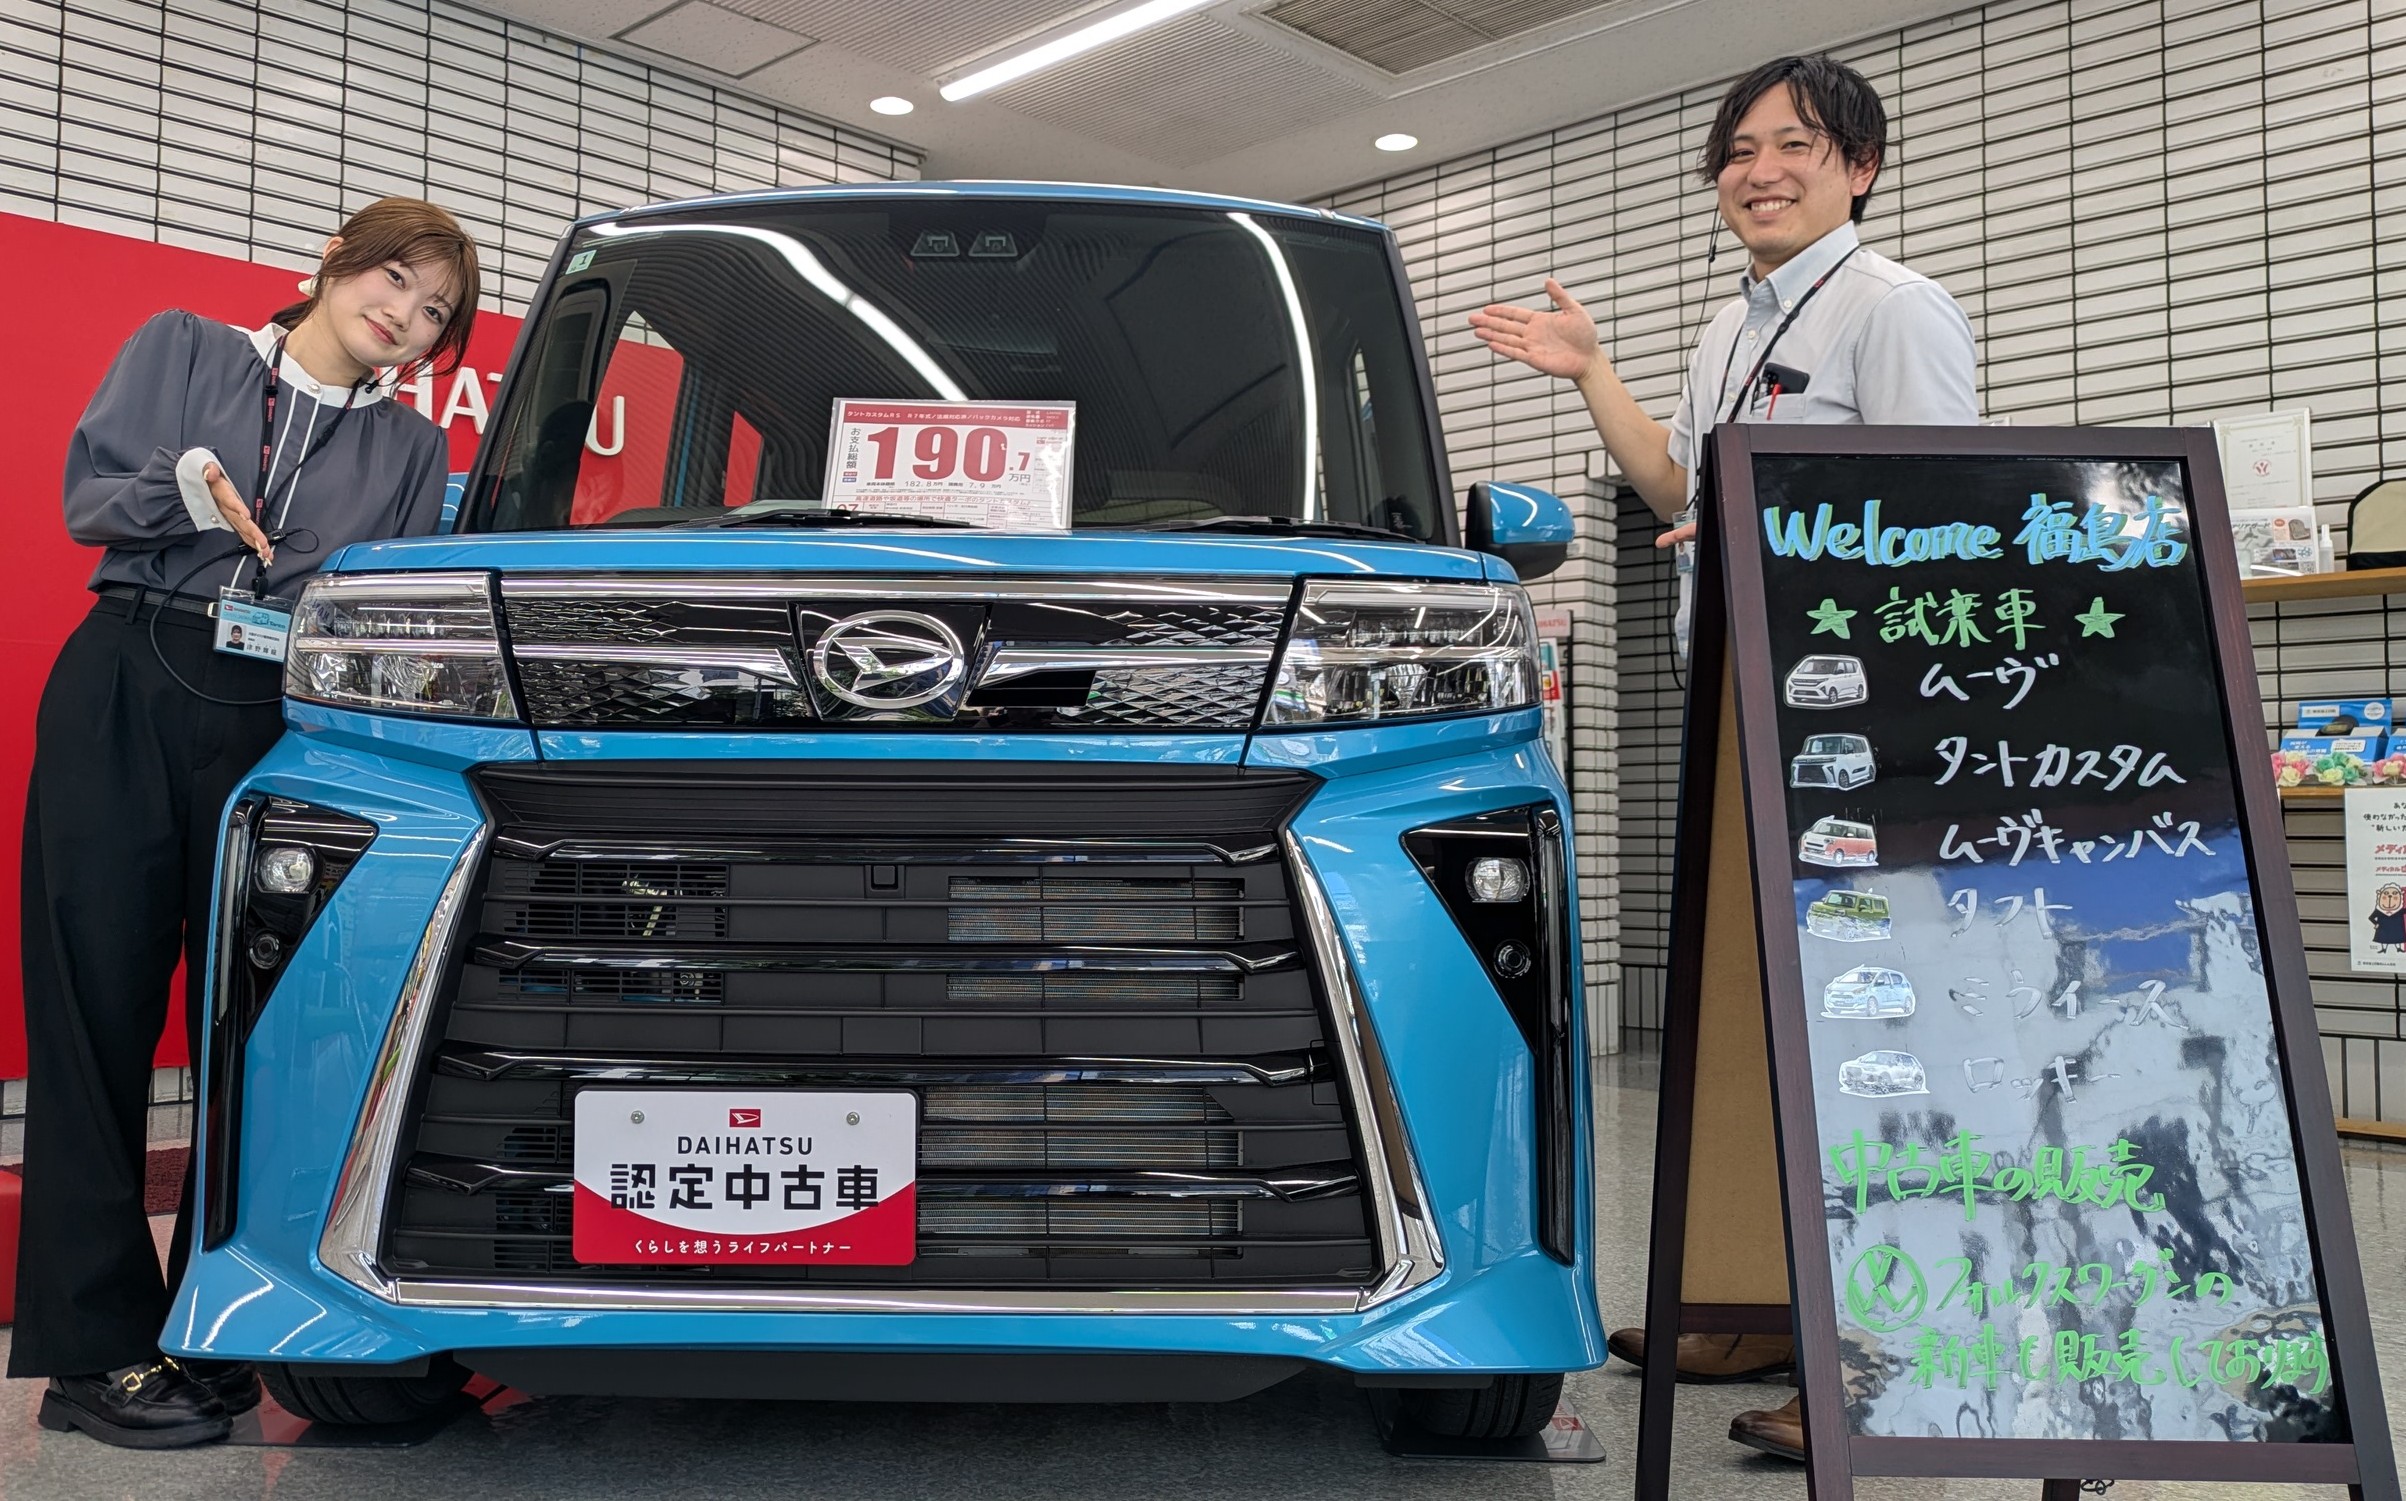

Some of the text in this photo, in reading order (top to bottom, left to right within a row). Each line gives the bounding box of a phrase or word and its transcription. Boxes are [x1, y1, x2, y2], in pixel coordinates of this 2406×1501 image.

[1008, 473, 1031, 483] 万円
[1763, 493, 2188, 572] Welcome 福島店
[1874, 587, 2046, 650] 試乗車
[1920, 653, 2060, 709] ムーヴ
[1934, 736, 2187, 791] タントカスタム
[1939, 808, 2216, 866] ムーヴキャンバス
[1948, 887, 2073, 939] タフト
[1949, 969, 2189, 1029] ミライース
[1962, 1055, 2121, 1103] ロッキー
[677, 1136, 813, 1155] DAIHATSU
[610, 1163, 879, 1211] 認定中古車
[1828, 1129, 2166, 1222] 中古車の販売
[634, 1240, 852, 1254] くらしを想うライフパートナー
[1934, 1247, 2234, 1316] フォルクスワーゲンの
